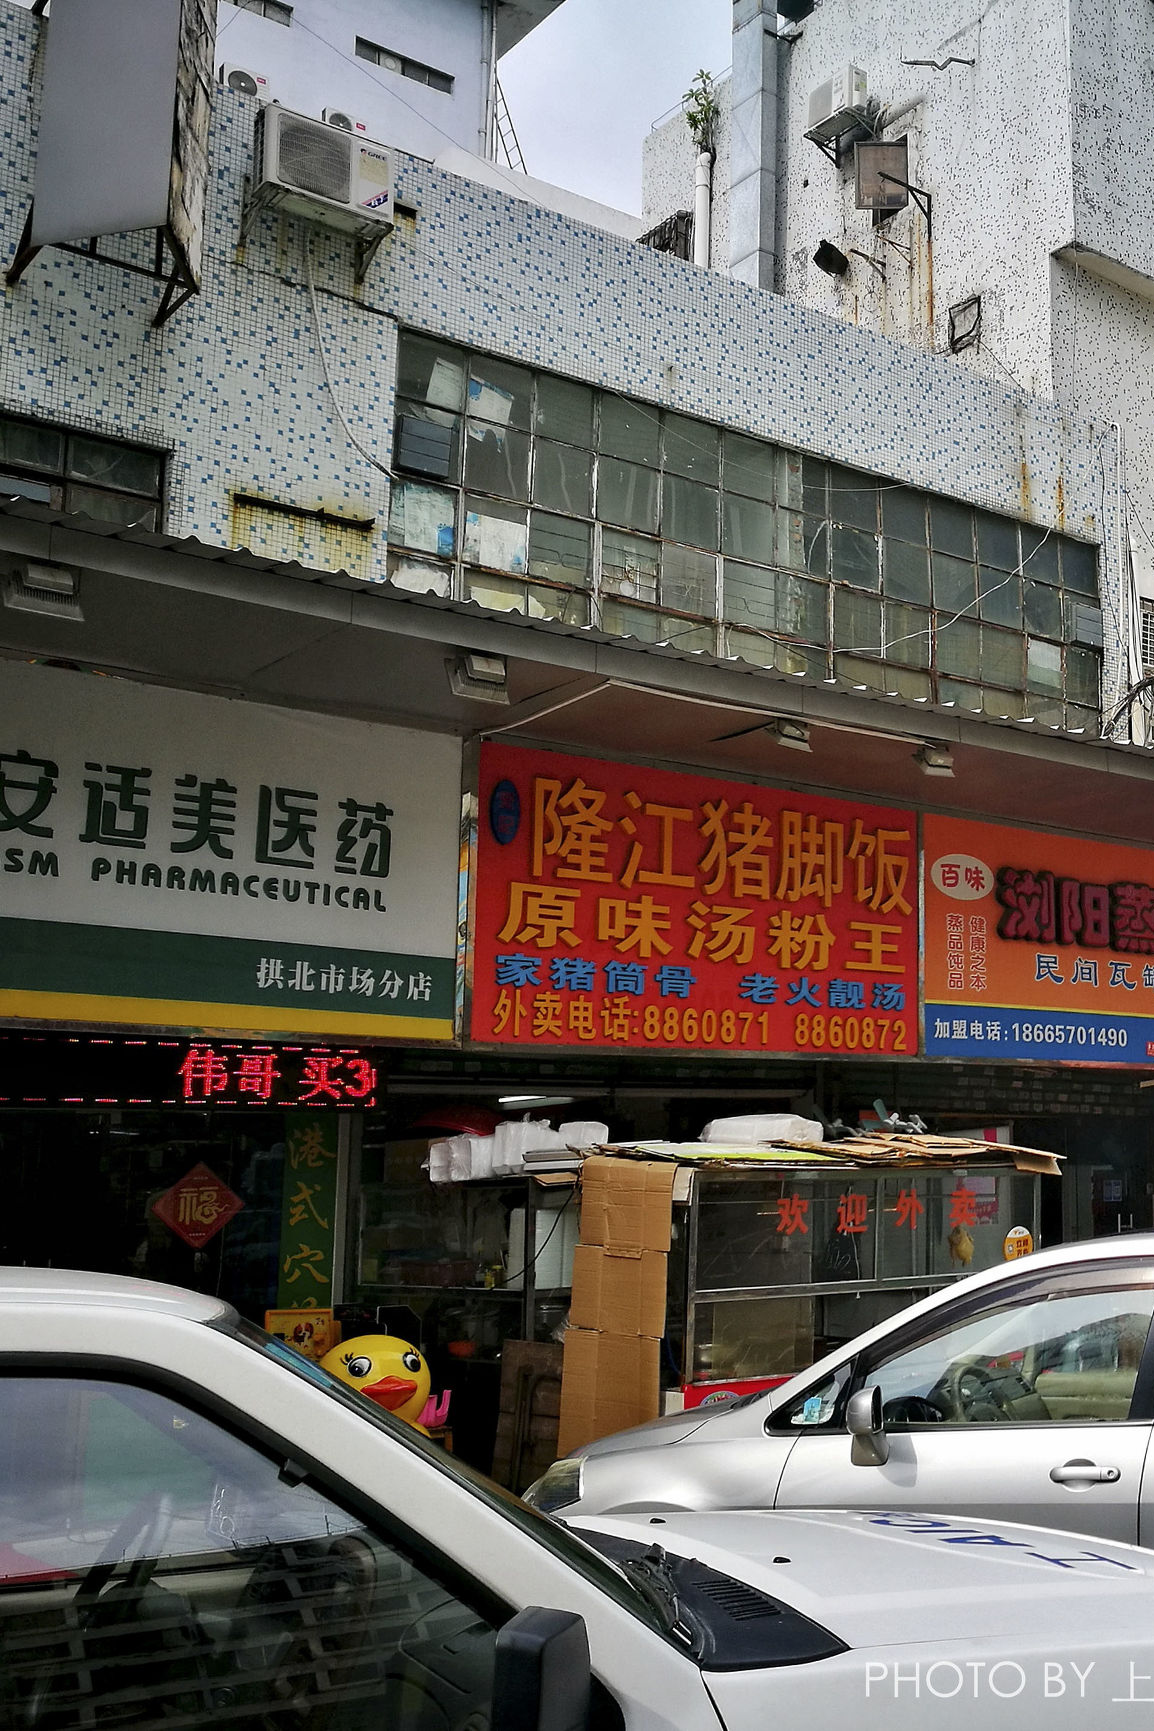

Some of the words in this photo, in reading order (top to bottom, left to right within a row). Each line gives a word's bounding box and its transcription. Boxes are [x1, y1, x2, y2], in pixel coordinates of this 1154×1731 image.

[0, 749, 394, 879] 安适美医药
[533, 776, 914, 916] 隆江猪脚饭
[91, 857, 387, 912] PHARMACEUTICAL
[940, 863, 986, 891] 百味
[497, 881, 907, 974] 原味汤粉王
[969, 915, 988, 992] 健康之本
[257, 957, 433, 1001] 拱北市场分店
[494, 954, 697, 999] 家猪筒骨
[739, 973, 907, 1011] 老火靓汤
[794, 1013, 908, 1051] 8860872
[178, 1049, 282, 1099] 伟哥
[178, 1185, 230, 1226] 福
[283, 1124, 336, 1309] 港式穴
[776, 1187, 978, 1235] 欢迎外卖
